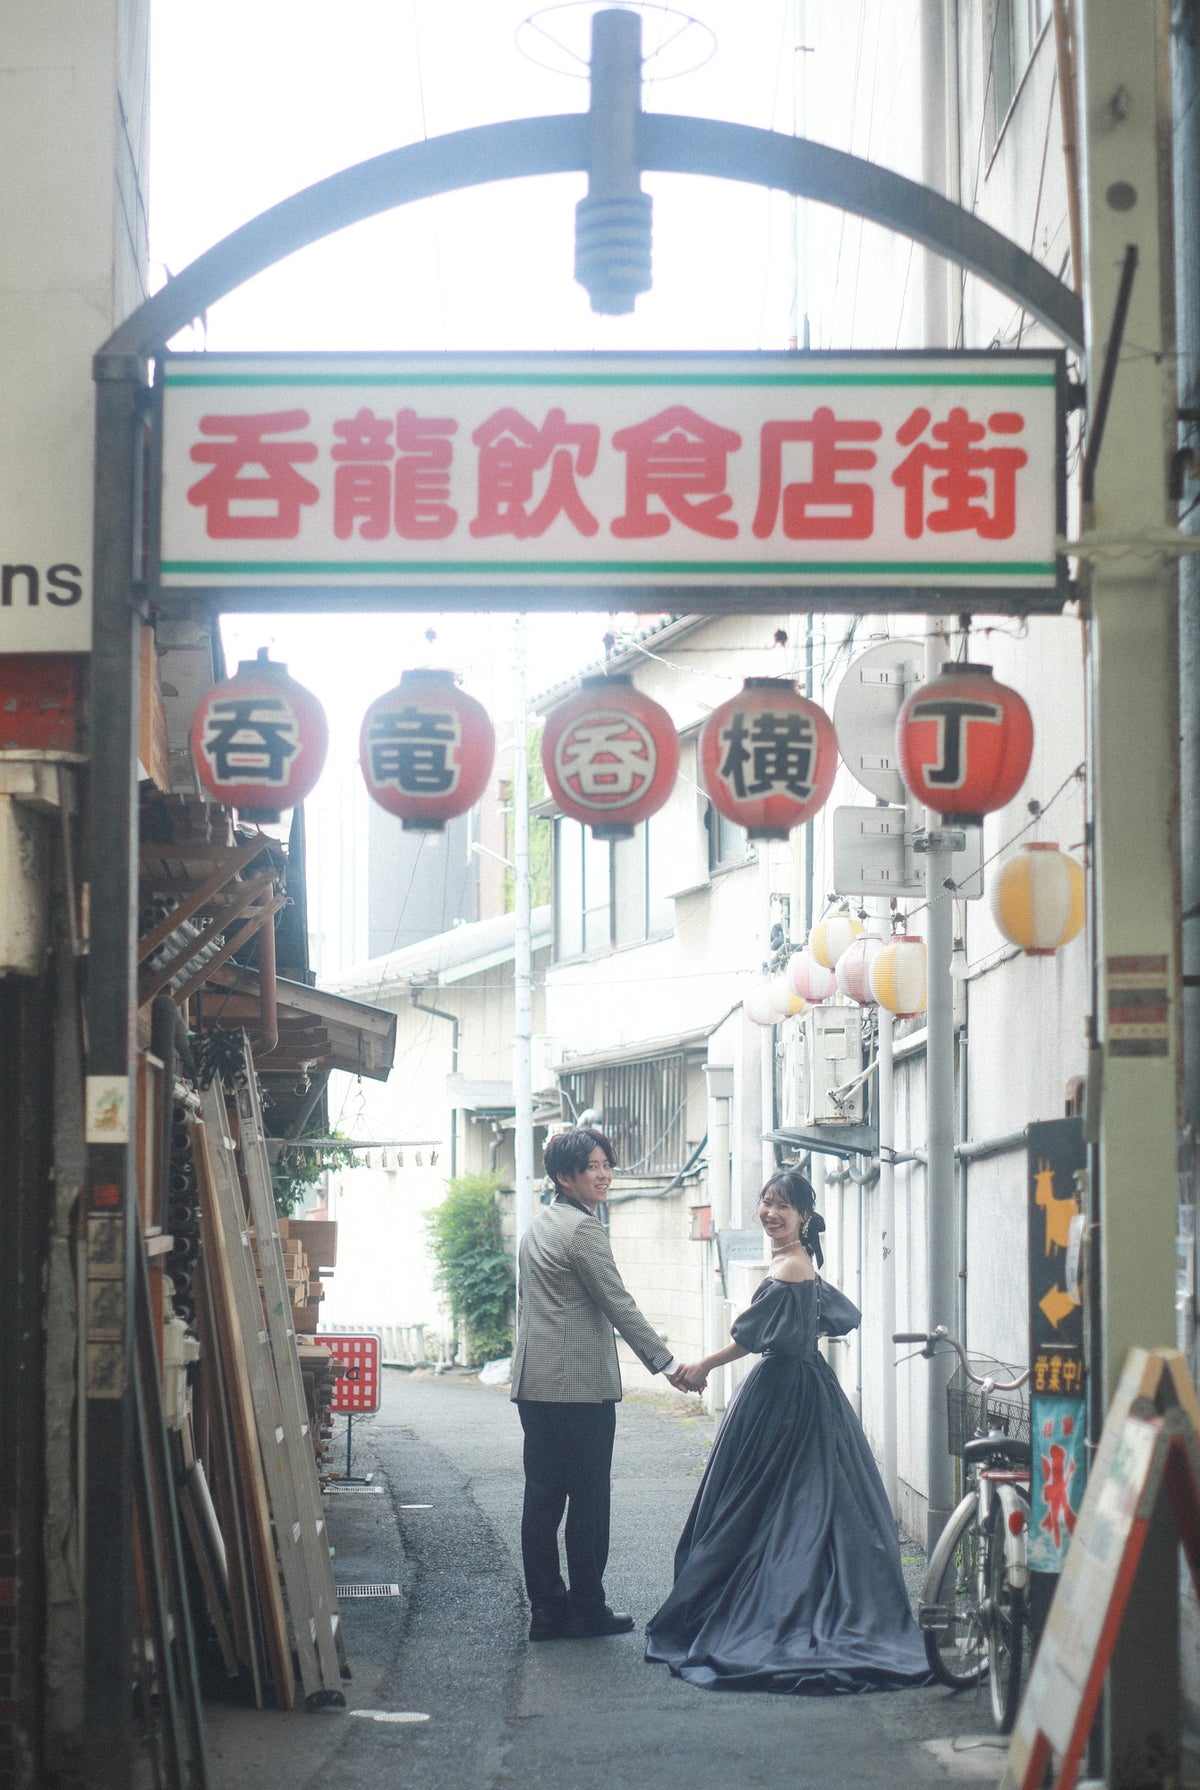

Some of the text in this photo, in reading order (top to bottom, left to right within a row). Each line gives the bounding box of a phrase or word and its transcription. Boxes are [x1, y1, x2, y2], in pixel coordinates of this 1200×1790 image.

[187, 405, 1028, 542] 呑龍飲食店街
[204, 697, 299, 784] 呑
[367, 705, 457, 795] 竜
[720, 711, 817, 800] 横
[910, 698, 1003, 788] 丁
[1039, 1443, 1078, 1550] 氷
